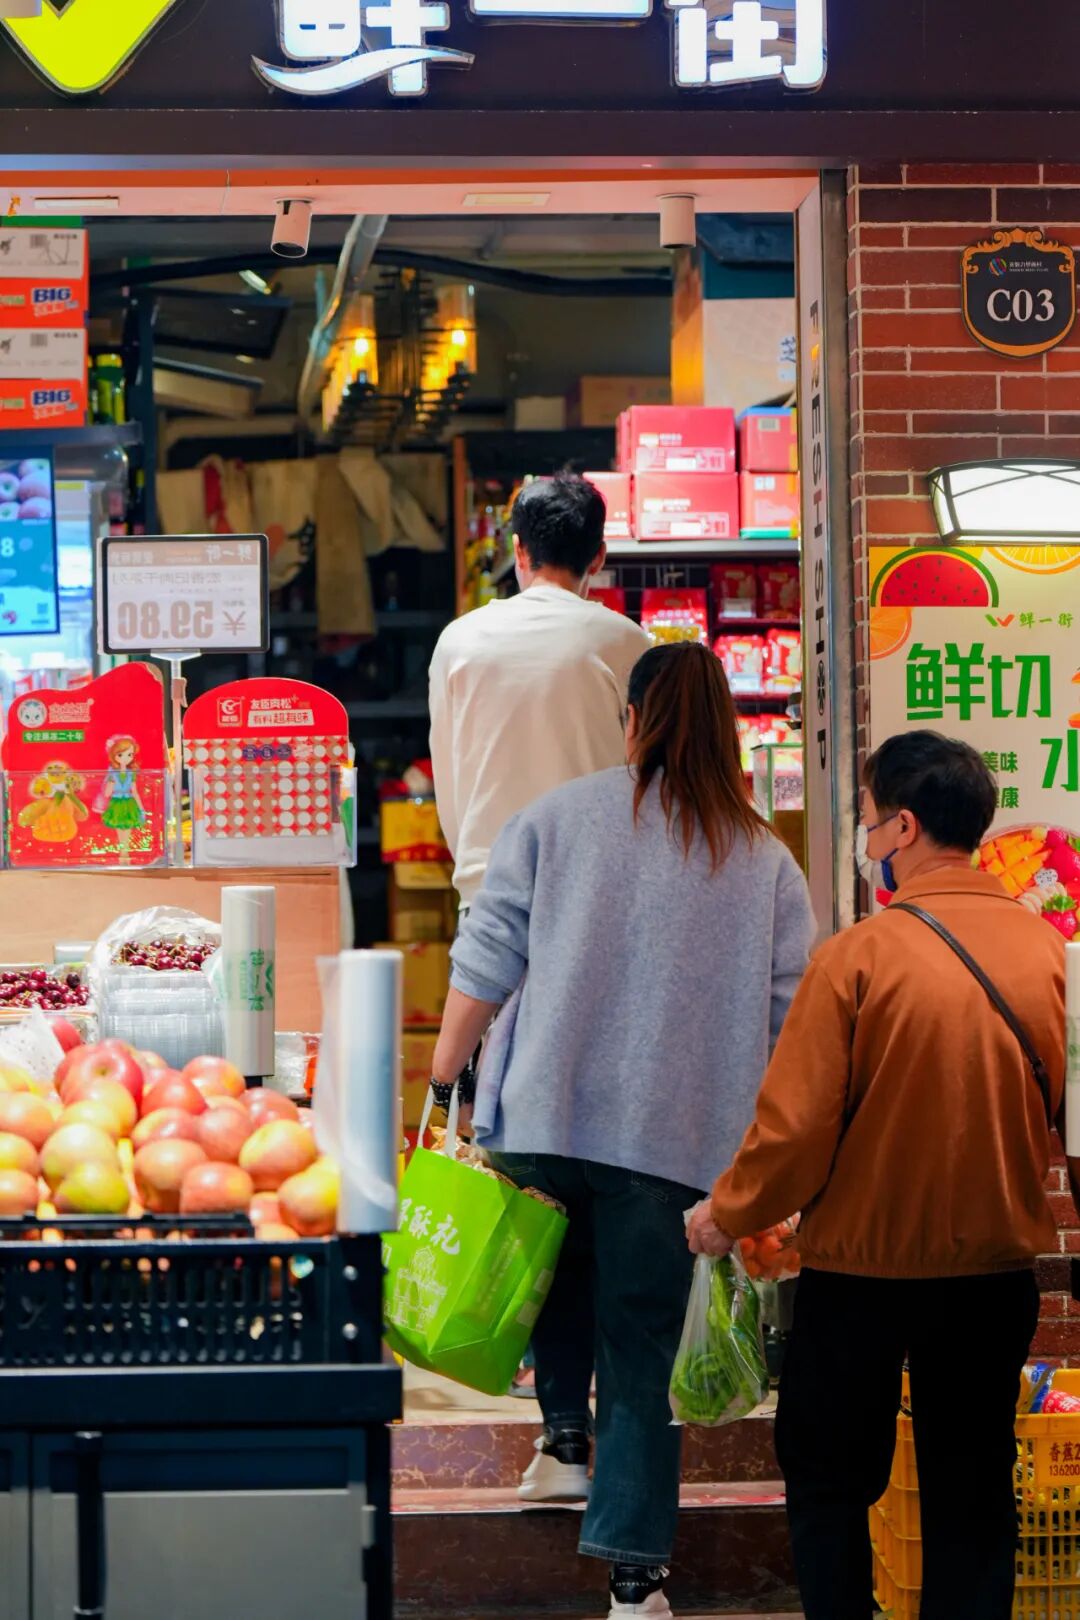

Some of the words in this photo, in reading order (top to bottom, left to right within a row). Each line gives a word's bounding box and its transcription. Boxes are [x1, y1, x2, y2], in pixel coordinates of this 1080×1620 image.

[32, 287, 71, 304] BIG
[986, 288, 1056, 322] C03
[32, 389, 71, 406] BIG
[906, 642, 1052, 721] 鲜切
[995, 786, 1020, 809] 康
